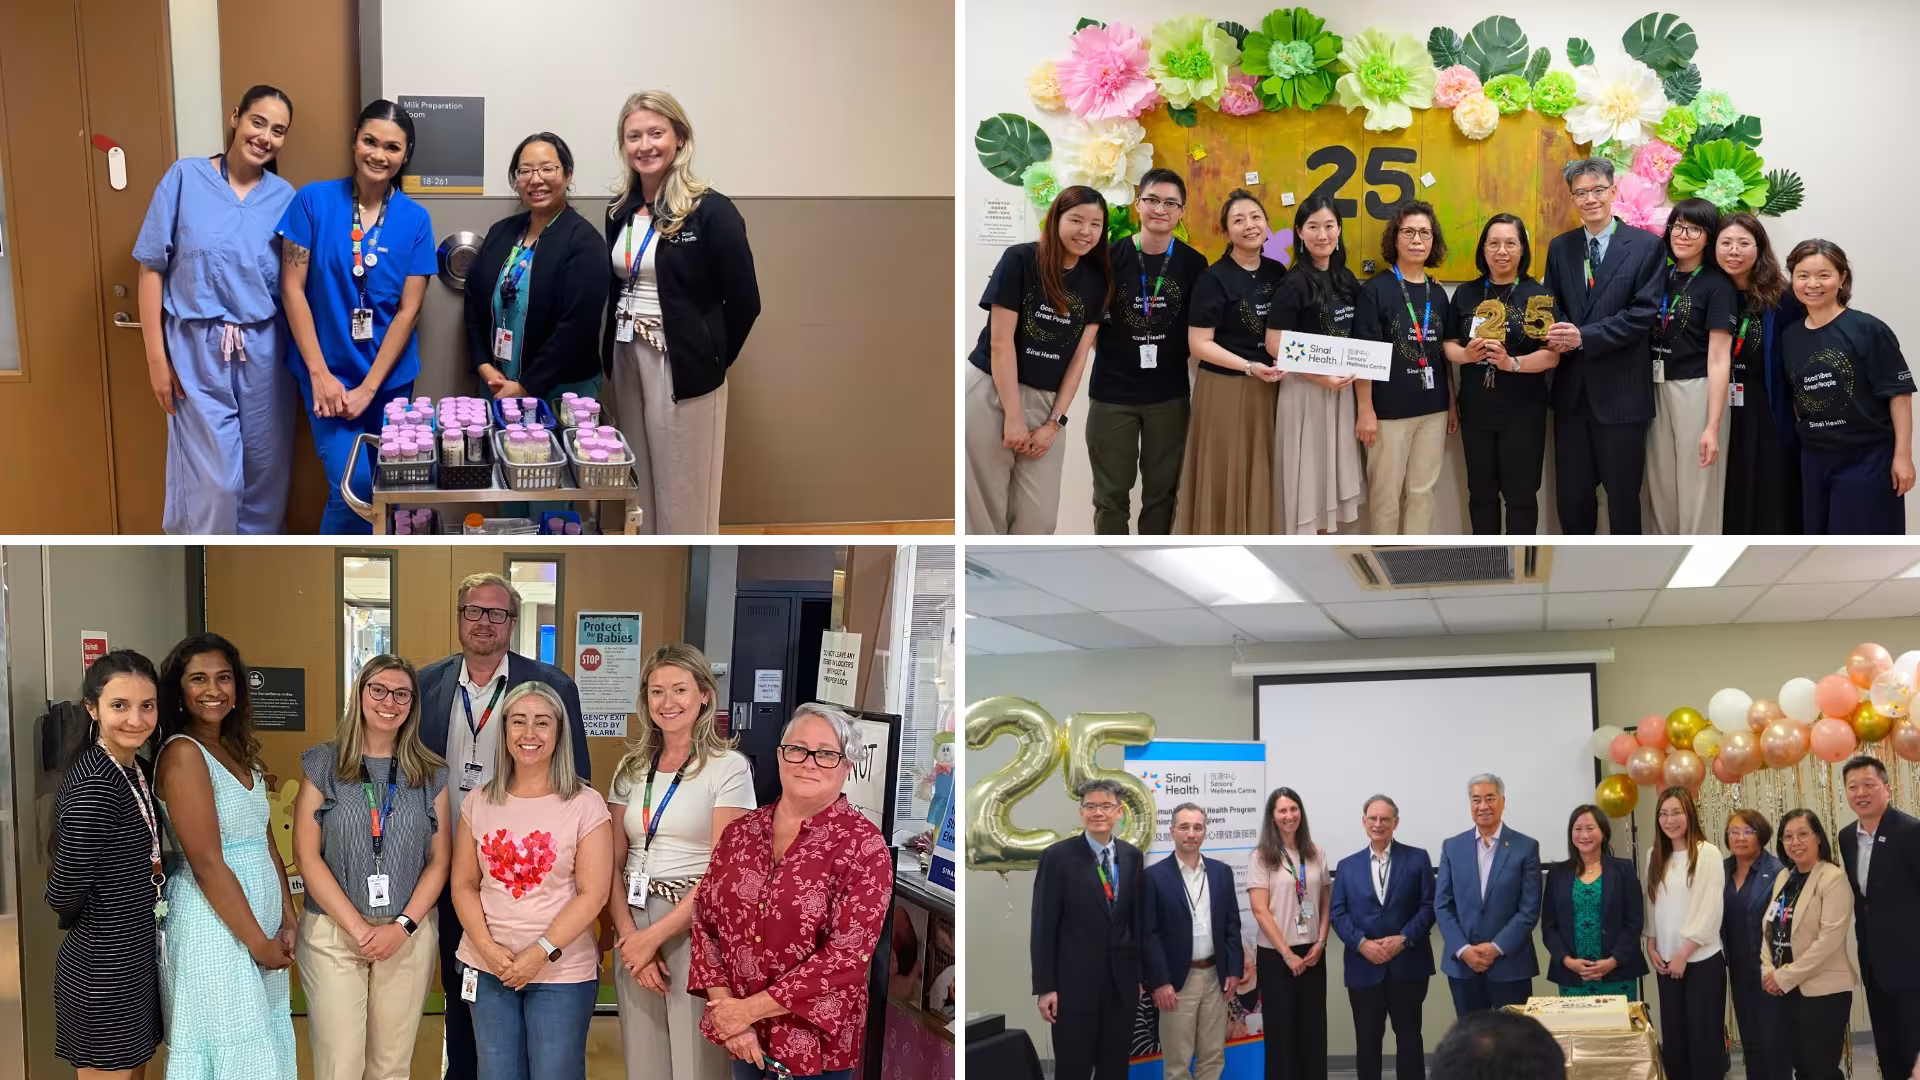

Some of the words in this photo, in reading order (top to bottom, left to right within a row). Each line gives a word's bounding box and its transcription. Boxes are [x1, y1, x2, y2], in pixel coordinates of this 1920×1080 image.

[404, 101, 419, 109] Milk
[421, 101, 463, 111] Preparation
[422, 177, 448, 186] 18-261
[1306, 145, 1417, 221] 25
[1034, 311, 1052, 320] Great
[1052, 315, 1071, 325] People
[1025, 347, 1041, 356] Sinai
[1041, 351, 1060, 360] Health
[1309, 344, 1332, 355] Sinai
[1308, 354, 1337, 365] Health
[1346, 361, 1369, 369] Wellness
[1803, 374, 1818, 383] Good
[1803, 383, 1819, 391] Great
[1818, 380, 1837, 388] People
[1808, 420, 1825, 428] Sinai
[1825, 419, 1847, 427] Health
[583, 621, 622, 632] Protect
[596, 632, 633, 643] Babies
[581, 654, 600, 665] STOP
[835, 651, 847, 659] LEAVE
[847, 652, 856, 660] ANY
[836, 660, 854, 669] LOCKERS
[838, 678, 848, 686] LOCK
[1165, 773, 1191, 783] Sinai
[965, 695, 1158, 872] 25
[1165, 784, 1199, 795] Health
[1207, 806, 1229, 814] Health
[1229, 806, 1257, 815] Program
[291, 880, 305, 890] th
